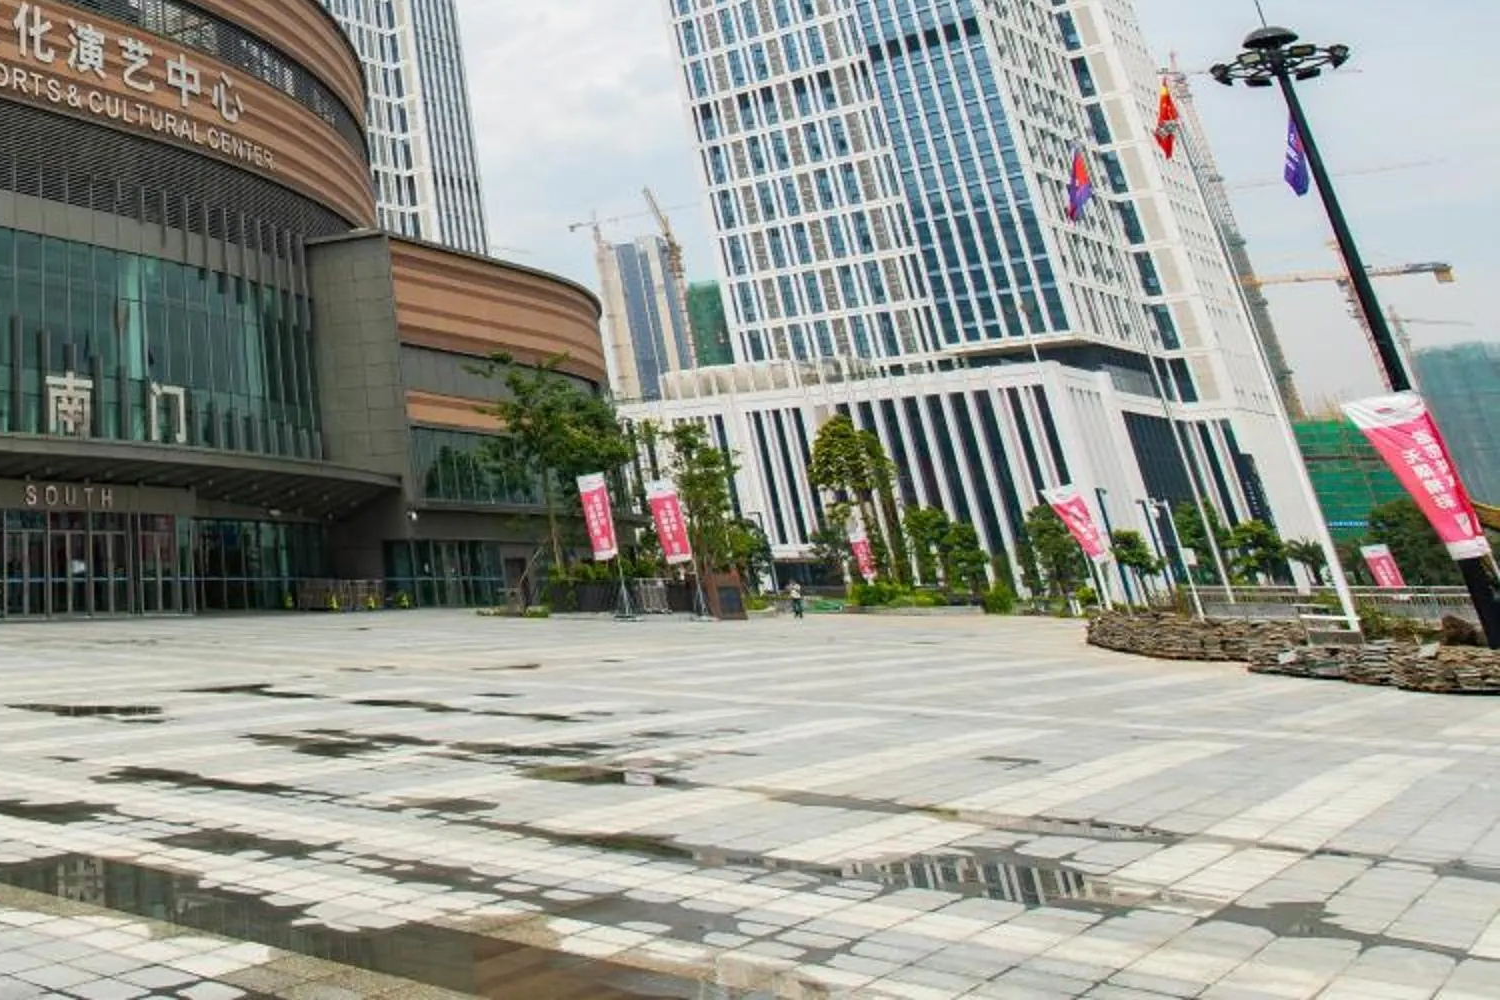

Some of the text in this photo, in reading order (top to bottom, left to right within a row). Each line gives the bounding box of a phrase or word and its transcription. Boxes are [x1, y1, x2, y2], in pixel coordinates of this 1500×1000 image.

[67, 85, 83, 109] &
[88, 91, 204, 146] CULTURAL
[207, 127, 277, 170] CENTER
[45, 370, 187, 443] 南门
[25, 484, 114, 509] SOUTH
